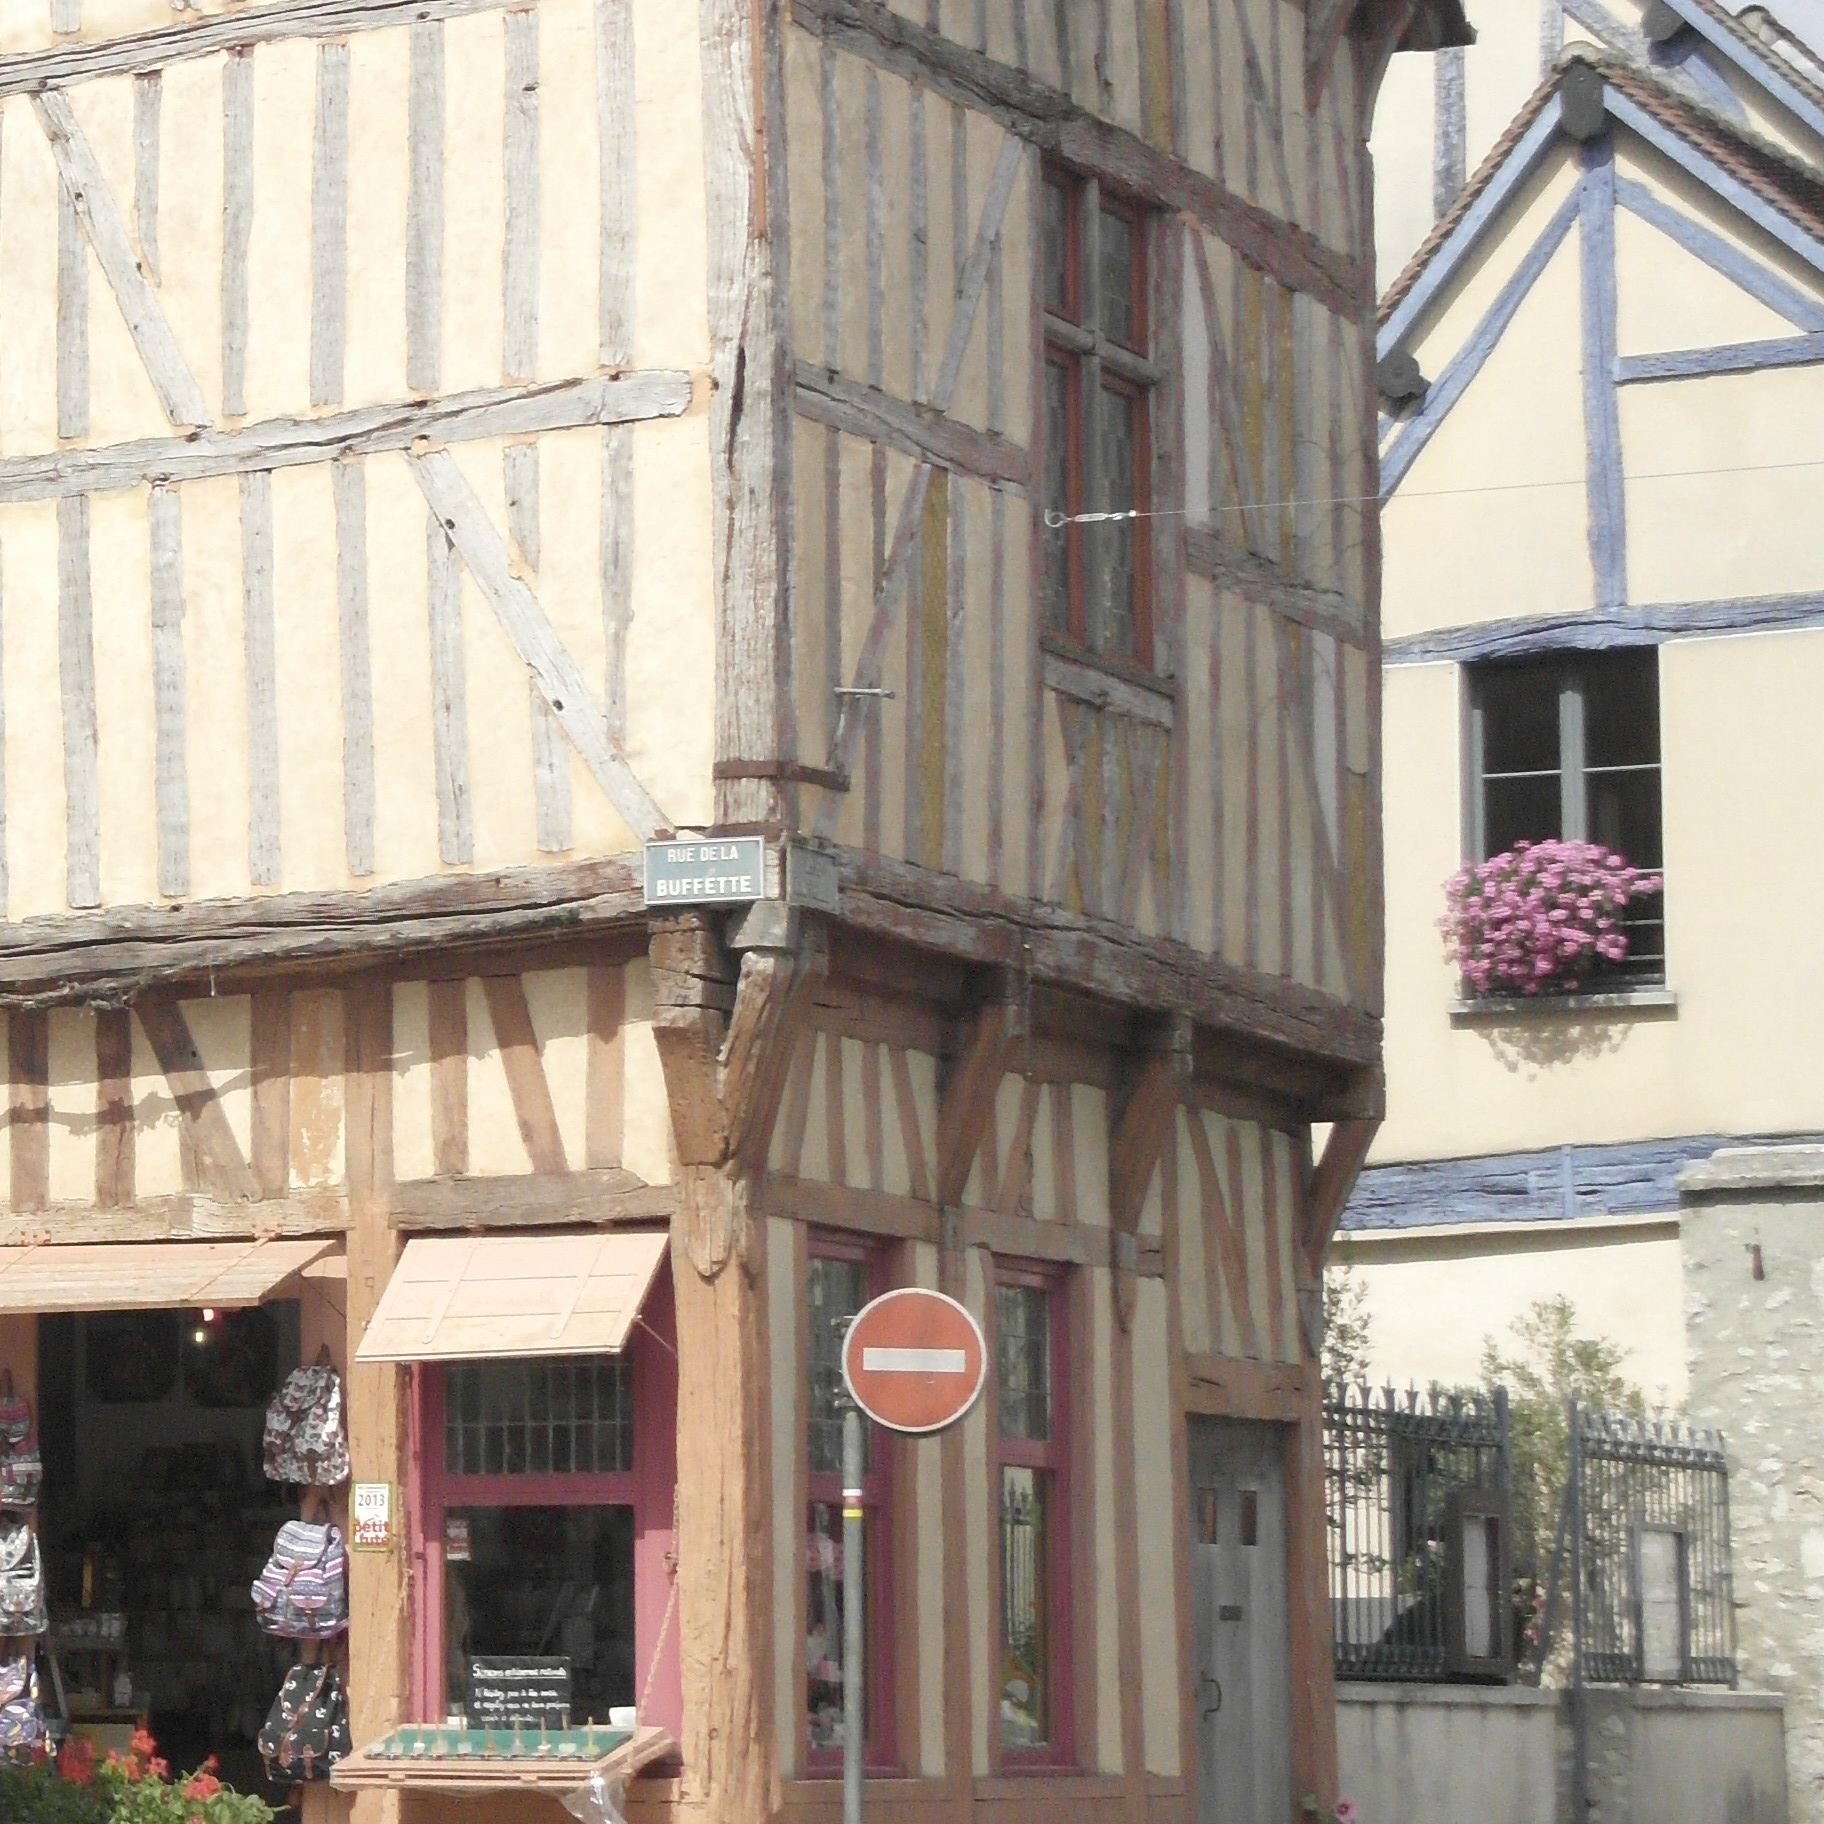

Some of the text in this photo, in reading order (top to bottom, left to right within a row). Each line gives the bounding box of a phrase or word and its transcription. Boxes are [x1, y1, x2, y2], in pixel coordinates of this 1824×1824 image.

[667, 845, 739, 863] RUE DE LA
[656, 875, 752, 897] BUFFETTE
[357, 1493, 386, 1507] 2013
